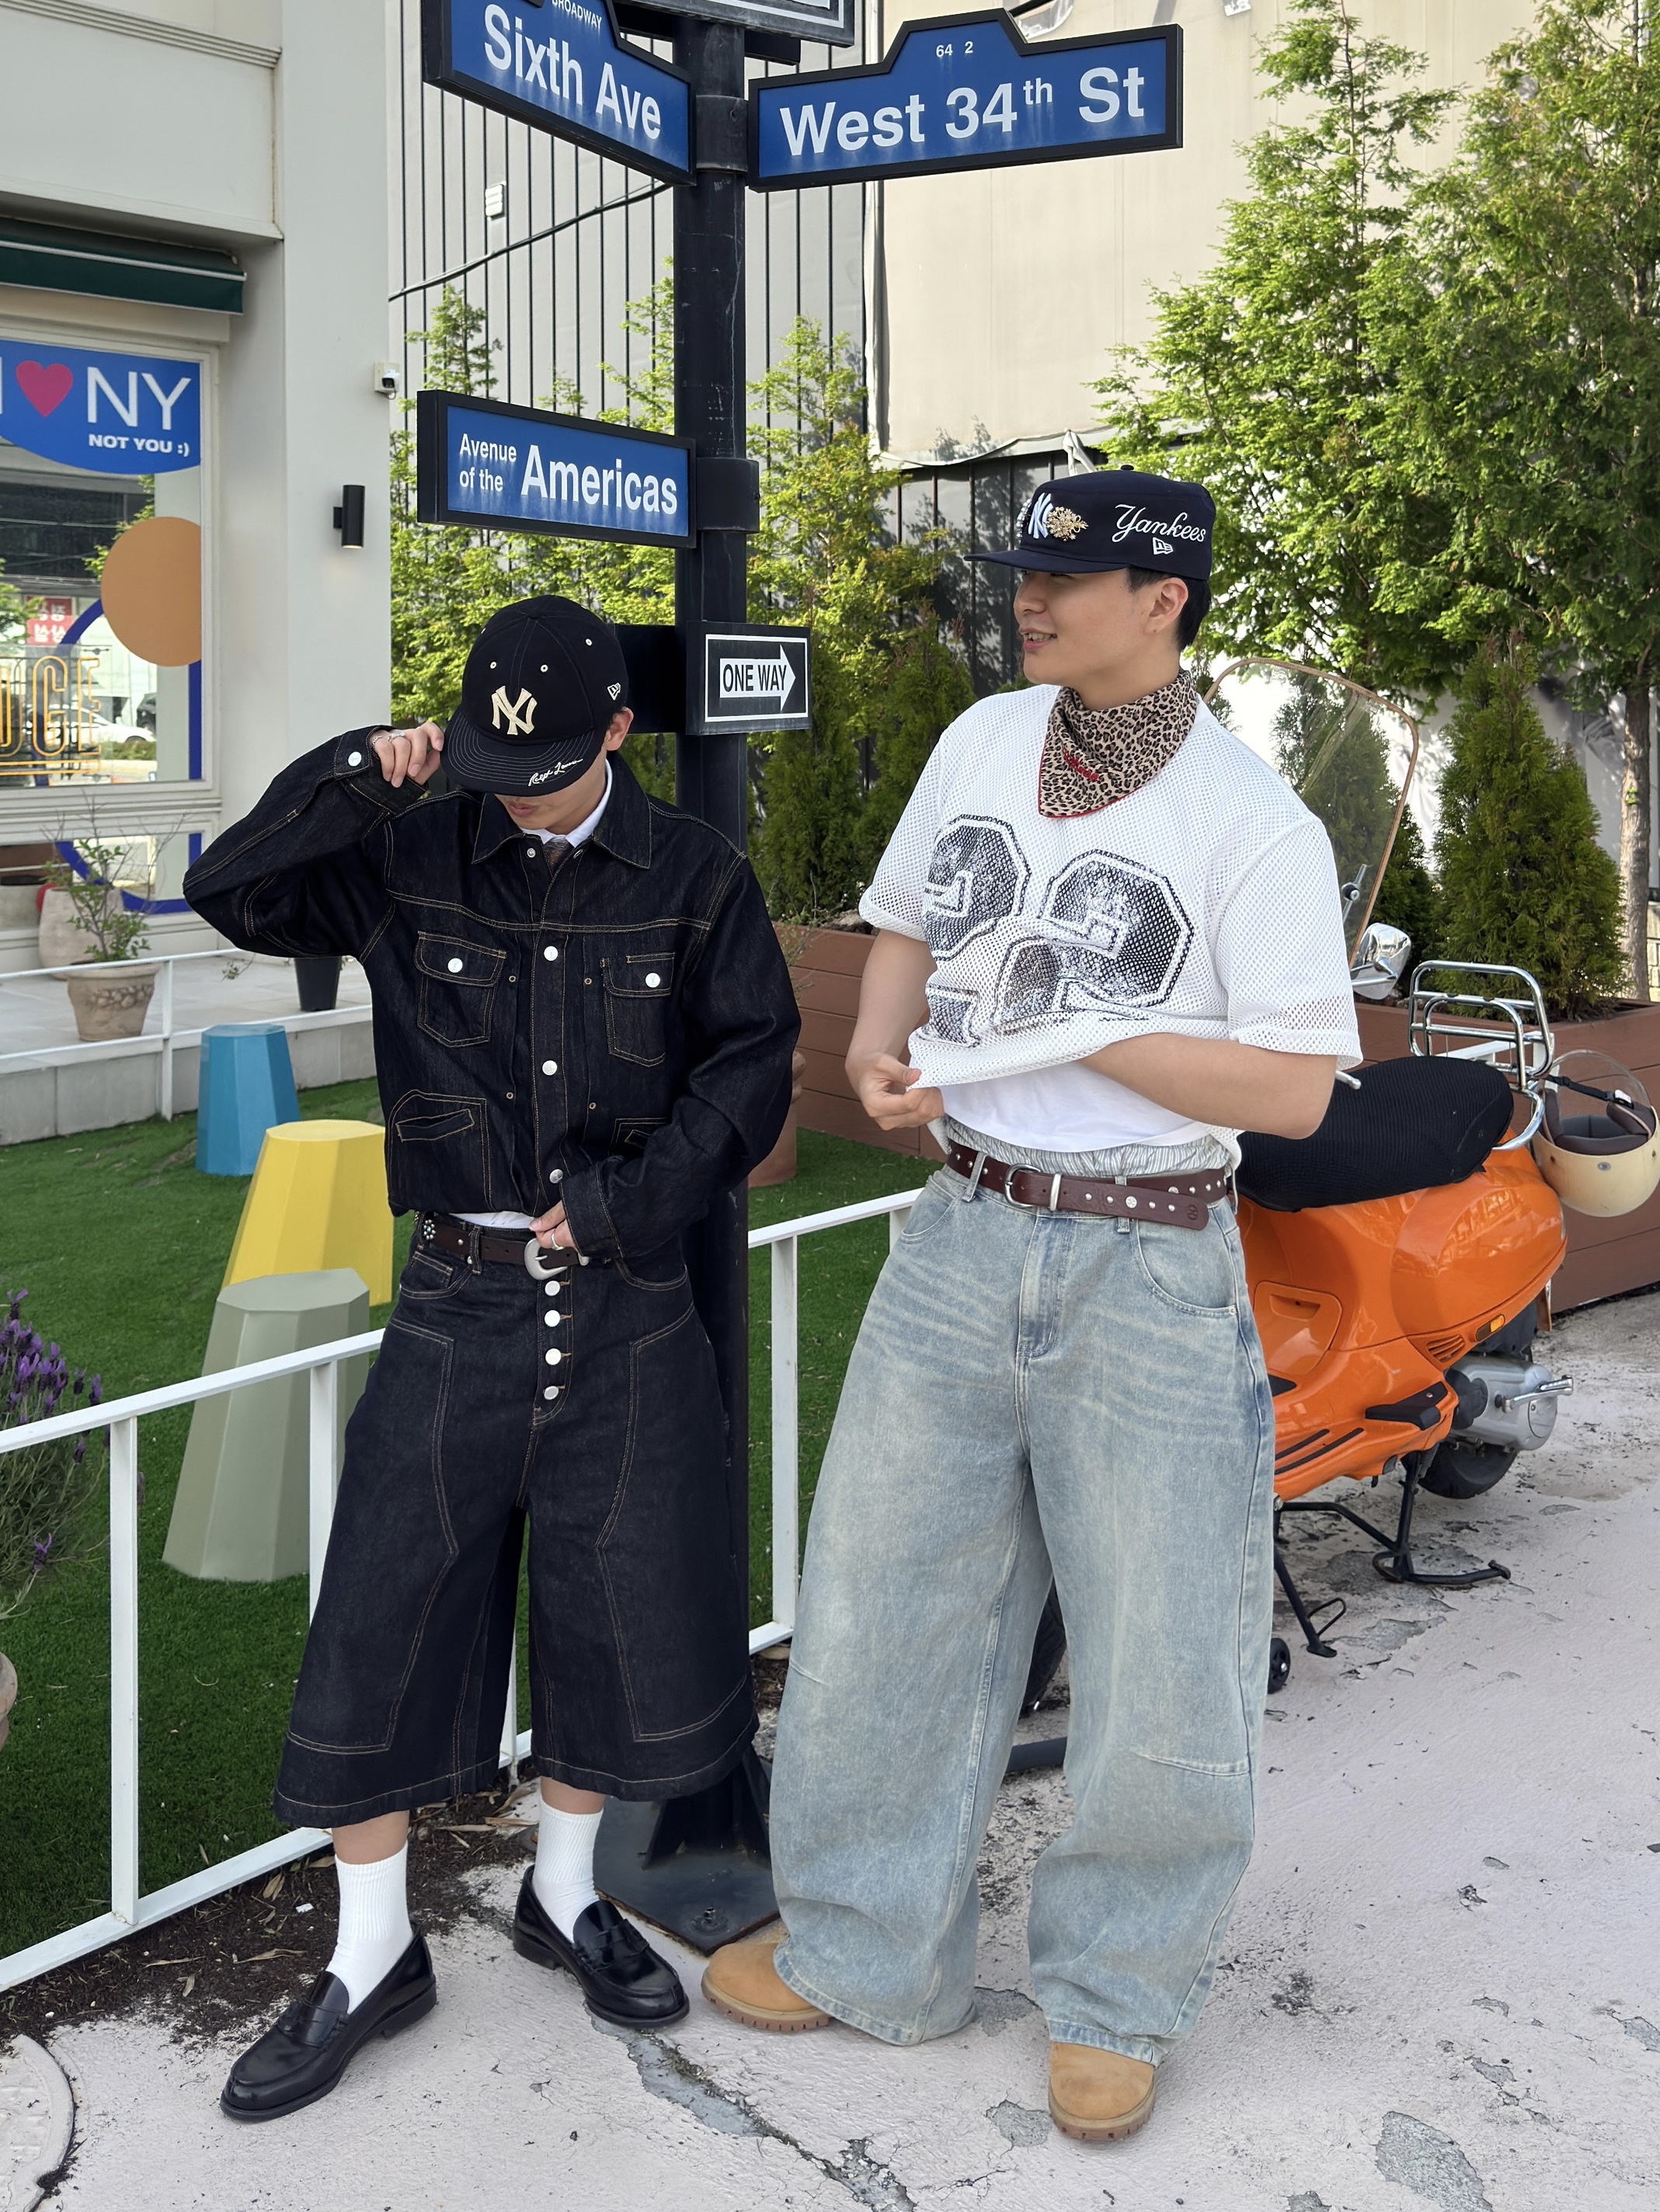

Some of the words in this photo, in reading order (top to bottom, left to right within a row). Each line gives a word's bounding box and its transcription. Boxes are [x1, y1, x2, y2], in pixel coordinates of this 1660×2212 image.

[935, 43, 953, 58] 64
[964, 40, 973, 54] 2
[484, 4, 583, 106] Sixth
[595, 61, 661, 140] Ave
[779, 94, 925, 156] West
[945, 77, 1053, 139] 34th
[1078, 67, 1144, 123] St
[87, 366, 191, 430] NY
[89, 433, 130, 449] NOT
[133, 437, 172, 454] YOU
[459, 433, 517, 463] Avenue
[459, 466, 475, 489] of
[479, 468, 503, 492] the
[520, 444, 677, 515] Americas
[1112, 503, 1206, 543] Yankees
[723, 664, 753, 692] ONE
[758, 665, 787, 690] WAY
[491, 685, 538, 736] NY
